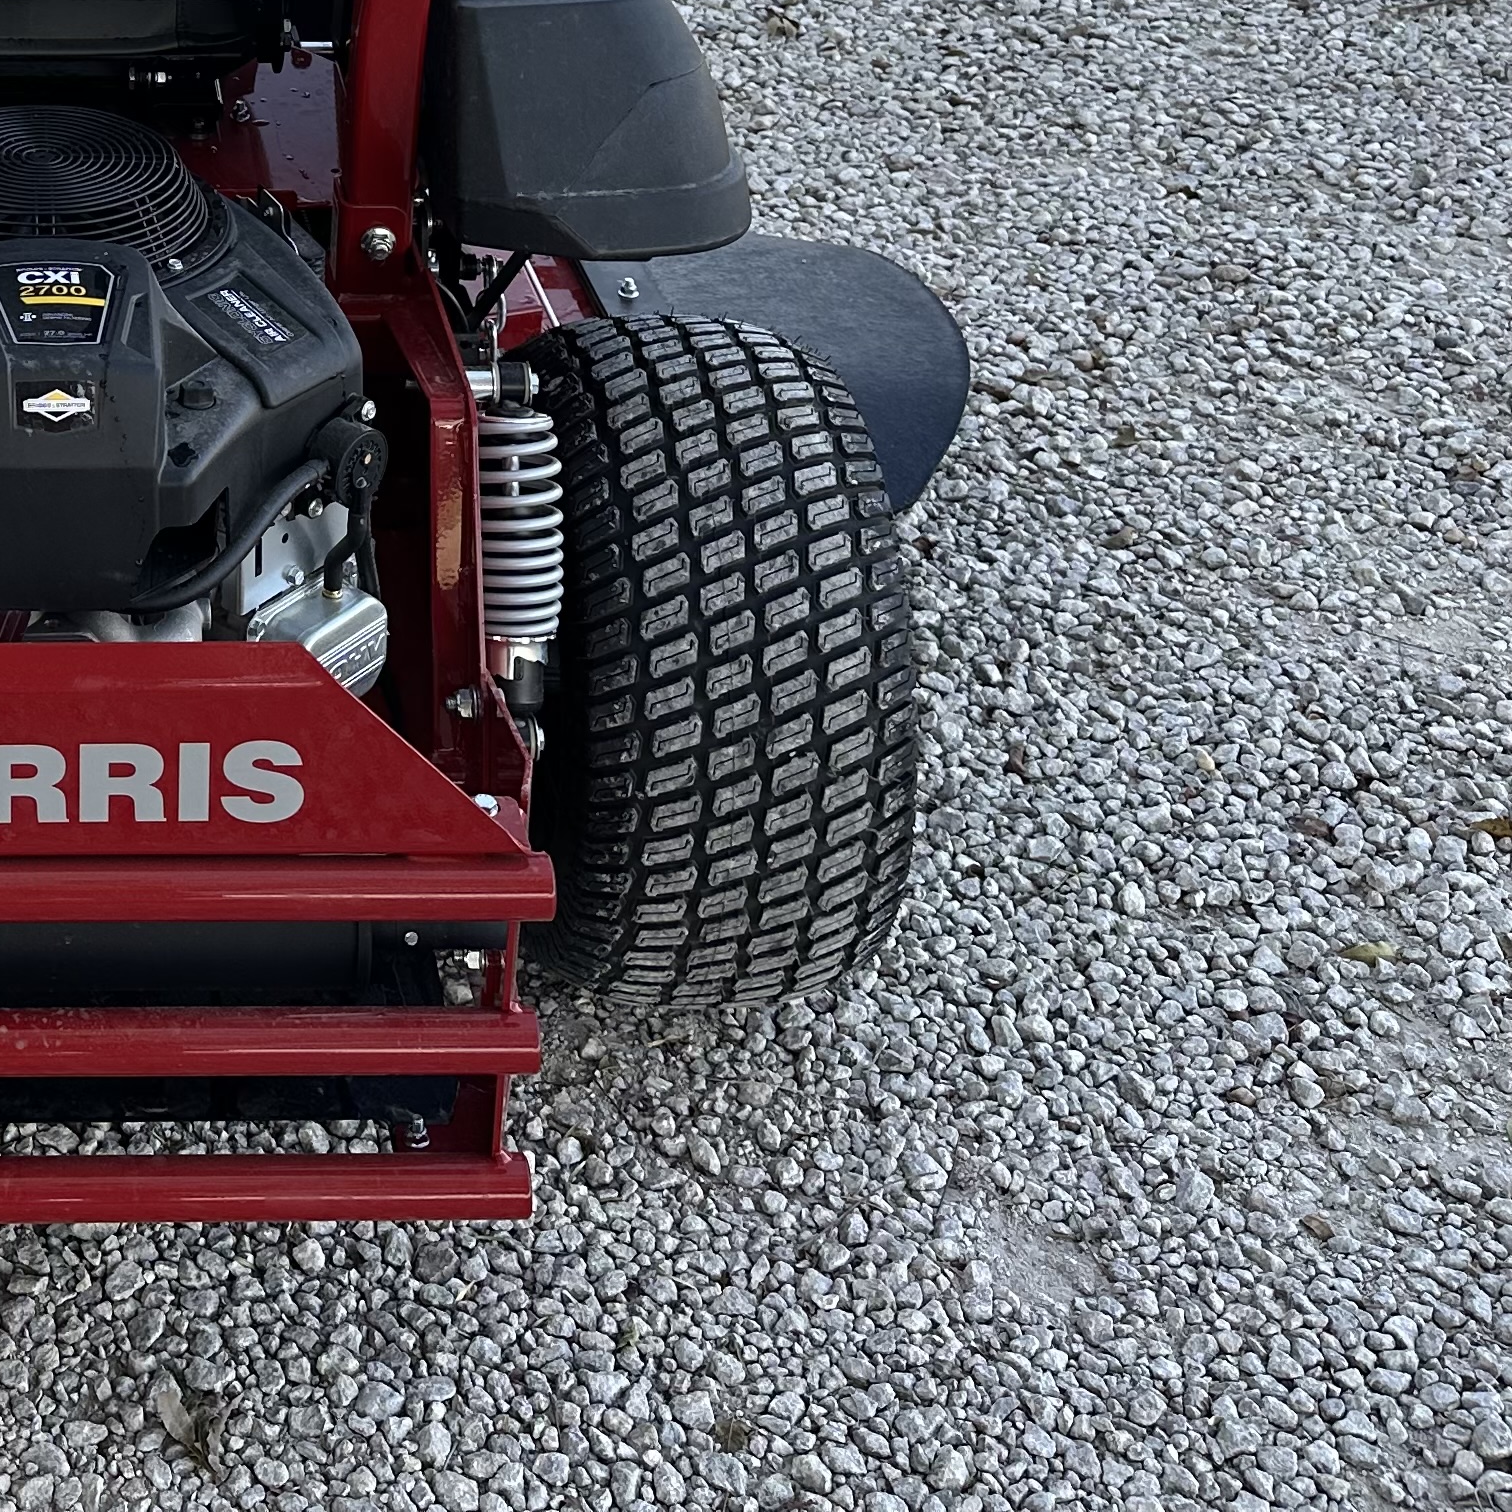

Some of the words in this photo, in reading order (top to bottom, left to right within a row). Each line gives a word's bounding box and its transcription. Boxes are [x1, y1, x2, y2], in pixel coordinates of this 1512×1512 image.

[19, 285, 87, 296] 2700
[220, 289, 267, 327] CLEANER
[264, 328, 287, 341] AIR
